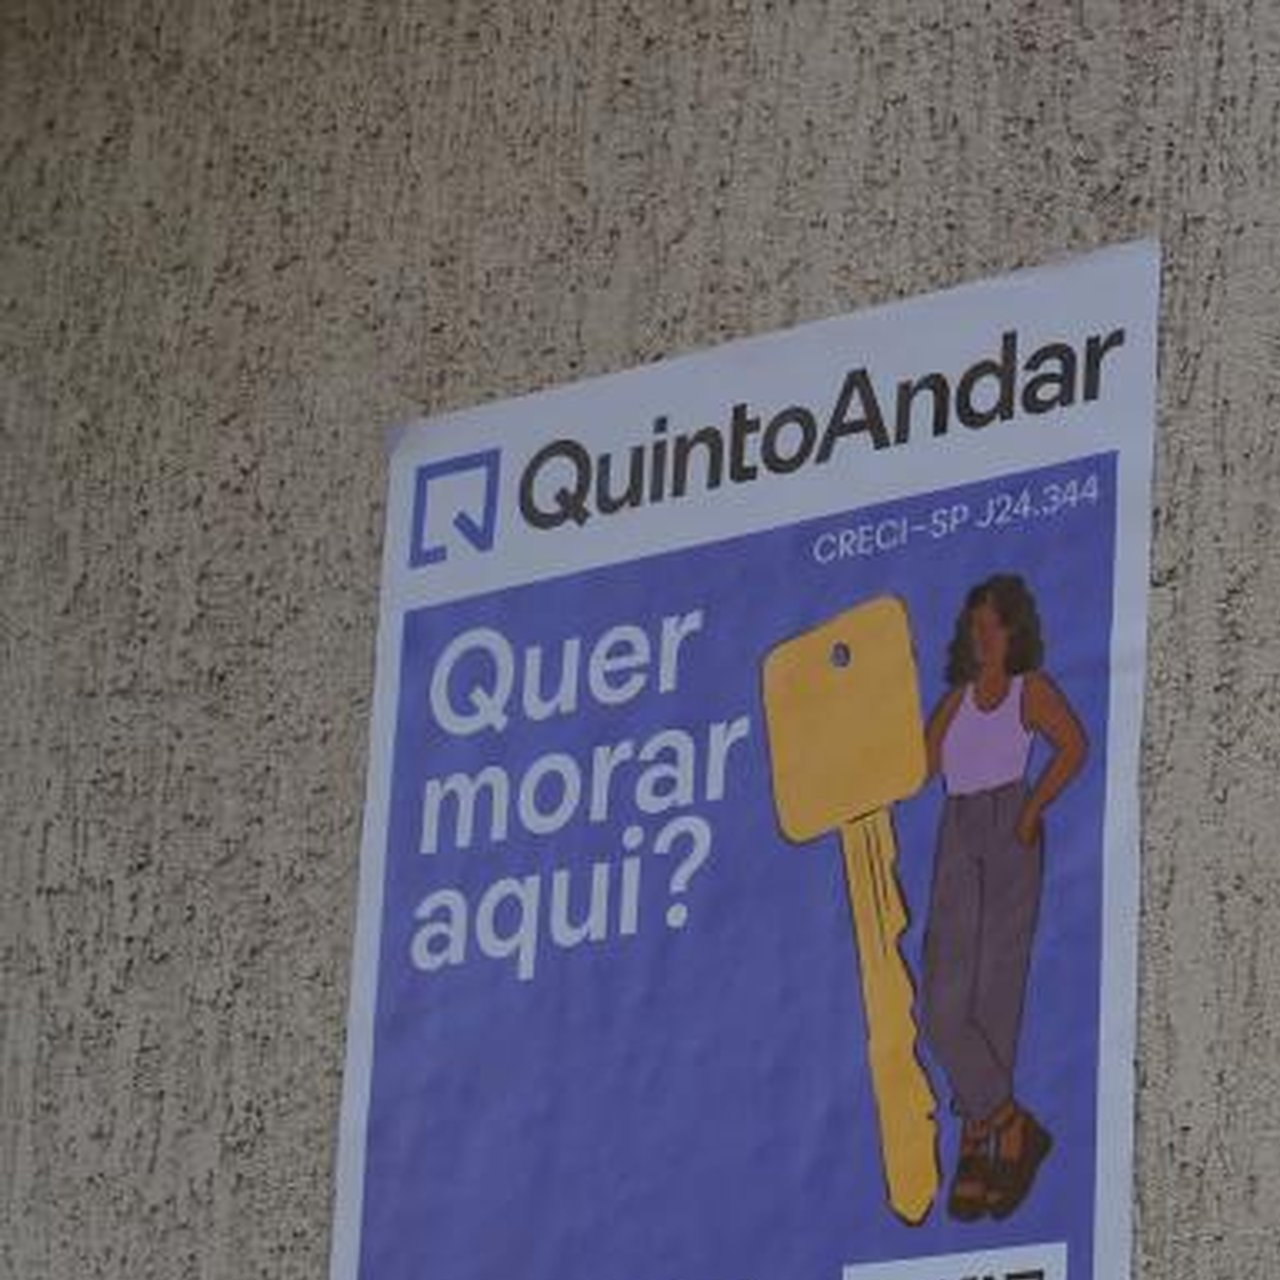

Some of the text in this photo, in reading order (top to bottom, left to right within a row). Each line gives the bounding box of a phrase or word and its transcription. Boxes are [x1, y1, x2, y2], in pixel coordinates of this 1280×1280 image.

[518, 330, 1125, 530] QuintoAndar
[813, 473, 1099, 563] CRECI-SP J24.344
[428, 609, 703, 736] Quer
[419, 715, 751, 855] morar
[410, 815, 713, 981] aqui?
